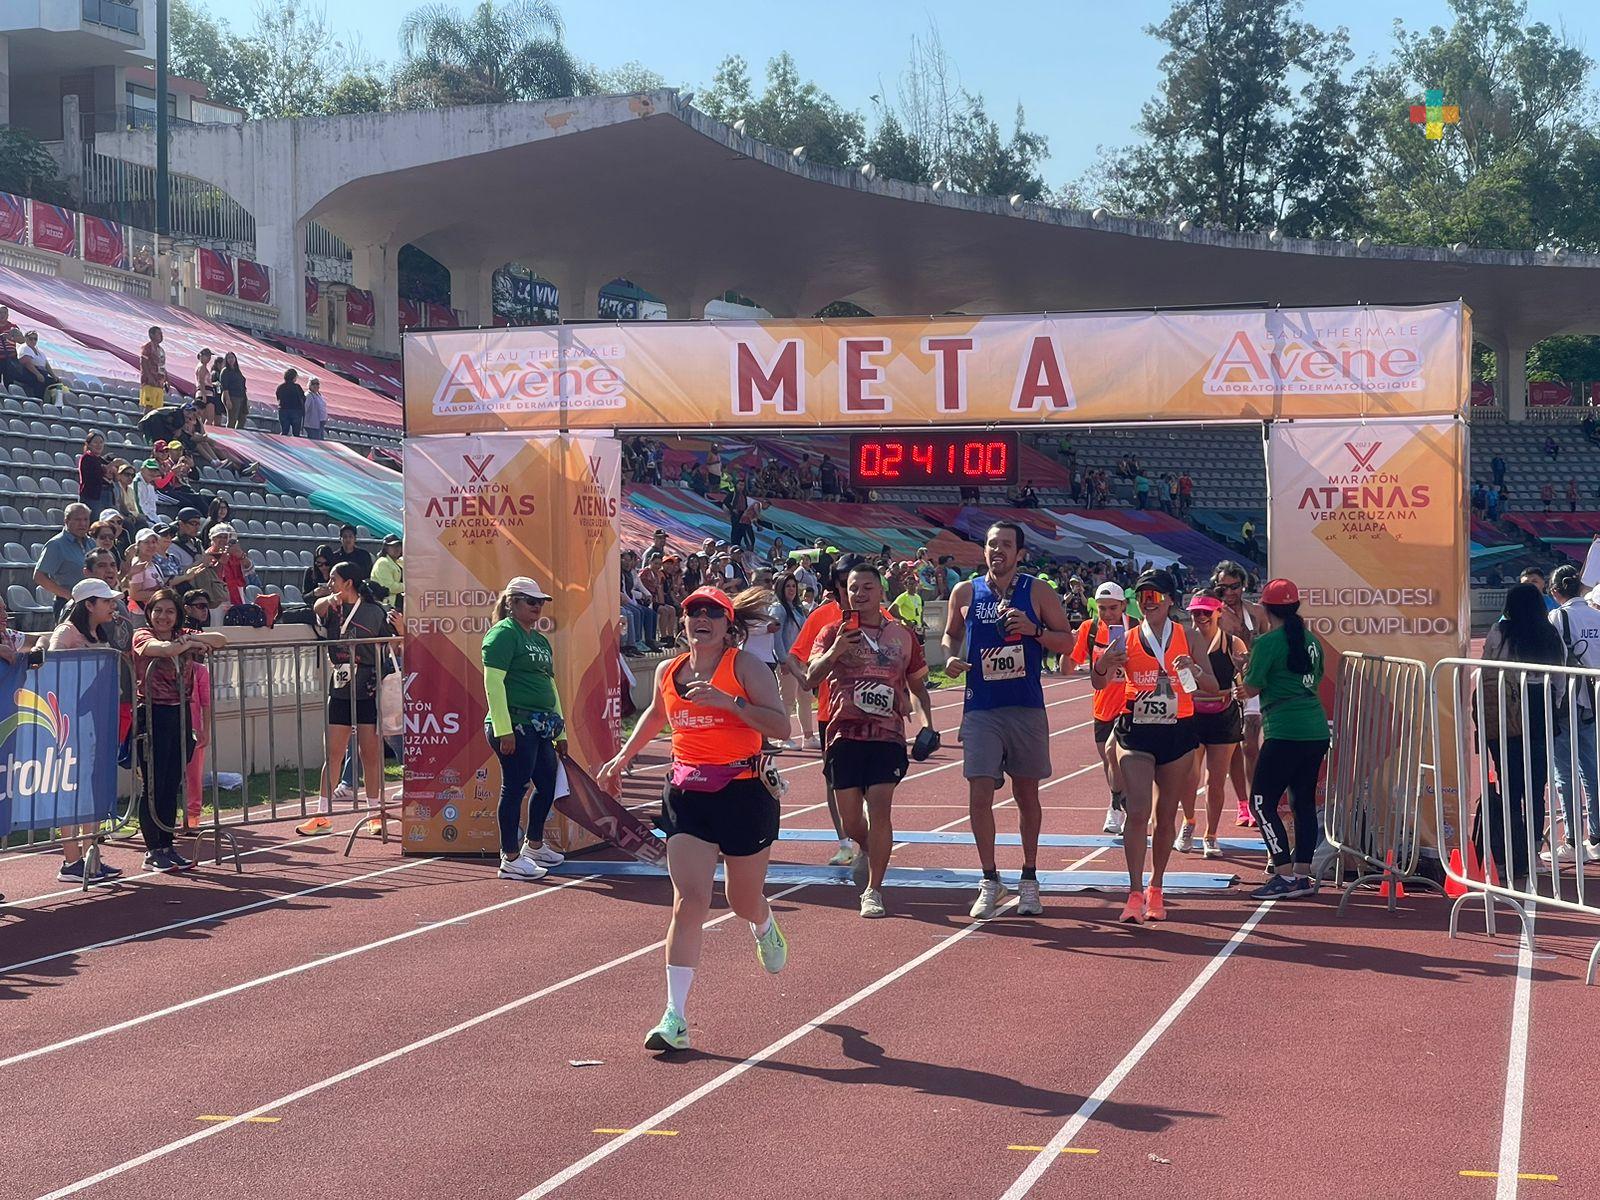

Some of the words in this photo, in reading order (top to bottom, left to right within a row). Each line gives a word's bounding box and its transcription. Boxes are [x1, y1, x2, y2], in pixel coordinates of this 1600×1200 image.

[1266, 330, 1303, 341] EAU
[1316, 325, 1419, 338] THERMALE
[486, 351, 519, 362] EAU
[529, 346, 619, 360] THERMALE
[1211, 330, 1418, 381] Avène
[439, 353, 619, 402] Avène
[735, 335, 1072, 413] META
[1209, 383, 1294, 393] LABORATOIRE
[1299, 380, 1418, 392] DERMATOLOGIQUE
[438, 402, 511, 414] LABORATOIRE
[516, 398, 620, 410] DERMATOLOGIQUE
[1328, 472, 1399, 485] MARATÓN
[450, 482, 509, 494] MARATÓN
[1298, 485, 1431, 510] ATENAS
[424, 494, 535, 518] ATENAS
[573, 495, 616, 518] ATENAS
[435, 518, 524, 528] VERACRUZANA
[1310, 510, 1417, 521] VERACRUZANA
[461, 529, 499, 539] XALAPA
[1342, 522, 1388, 533] XALAPA
[406, 617, 455, 633] RETO
[1337, 616, 1450, 635] CUMPLIDO
[1580, 628, 1599, 639] JUEZ
[989, 656, 1015, 671] 780
[860, 691, 889, 708] 1665
[1142, 701, 1167, 715] 753
[1254, 794, 1283, 855] PINK
